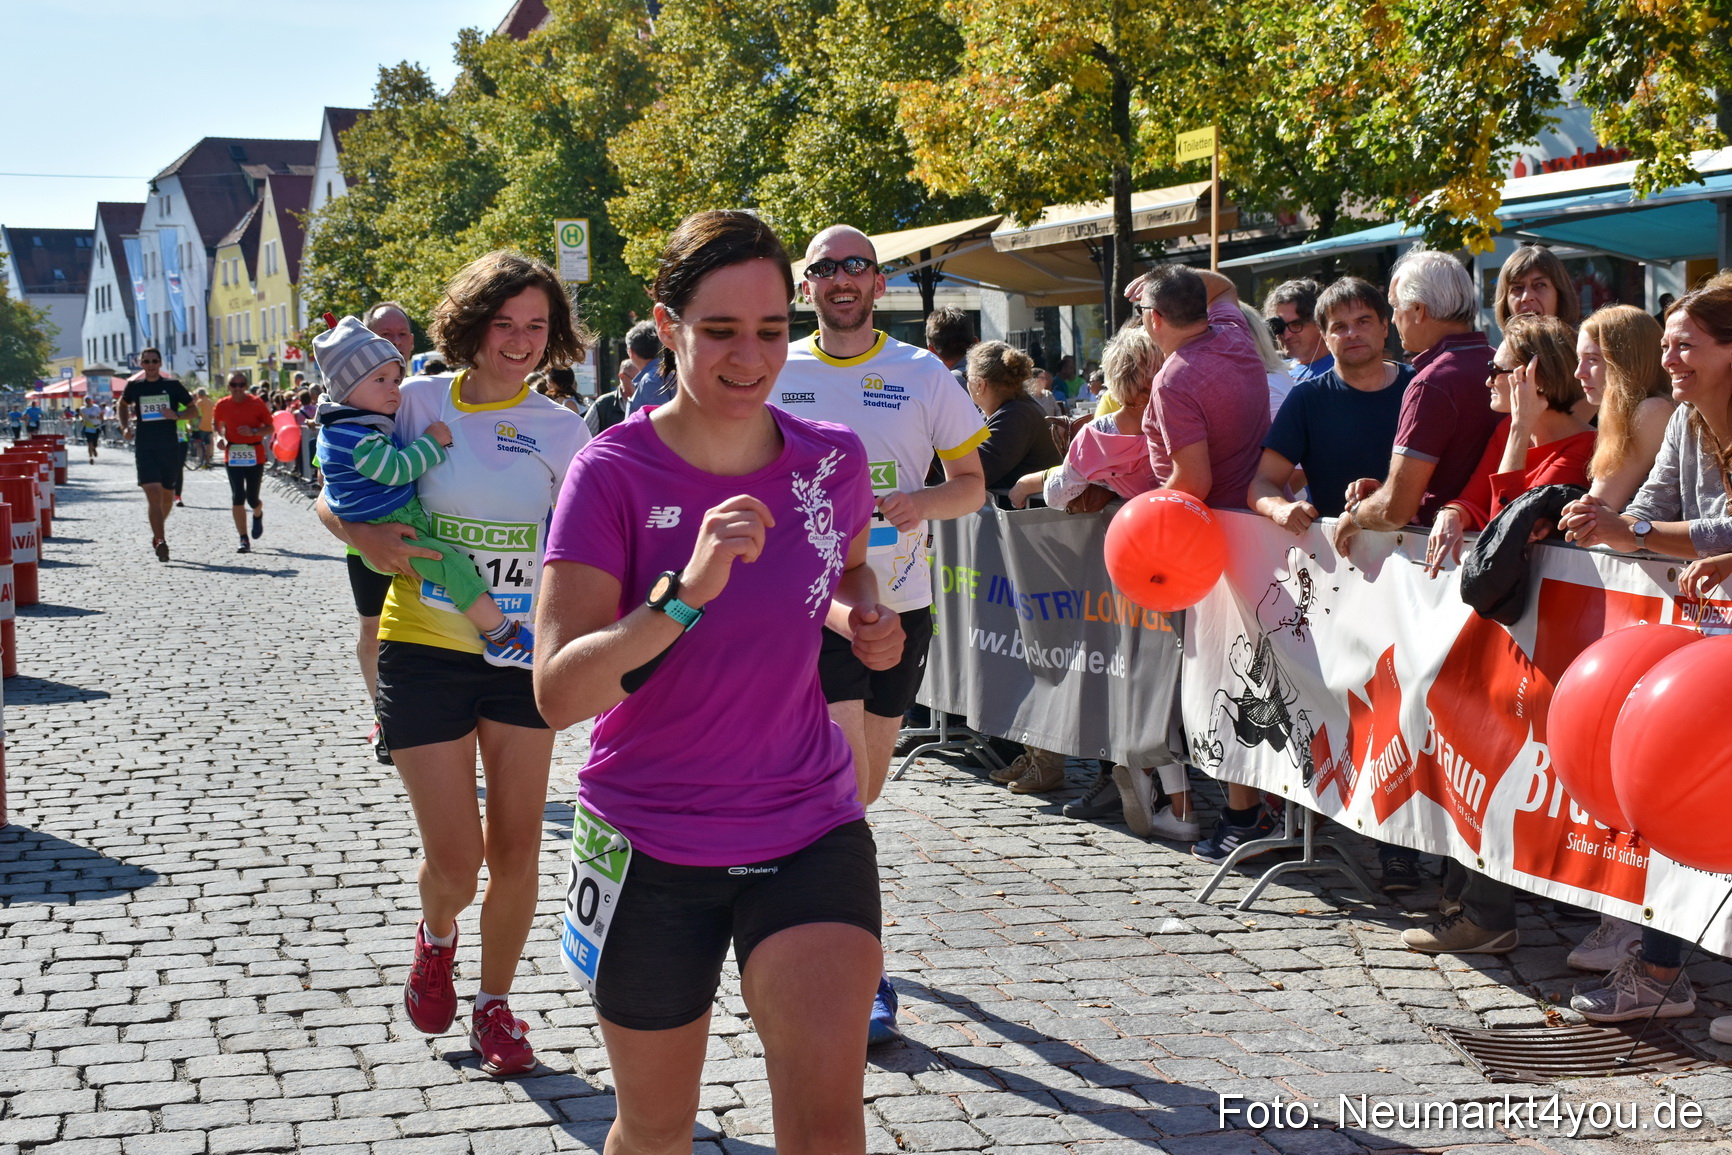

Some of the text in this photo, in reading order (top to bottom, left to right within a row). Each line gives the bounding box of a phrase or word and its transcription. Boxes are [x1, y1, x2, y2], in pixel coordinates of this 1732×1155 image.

[1183, 138, 1213, 153] Toiletten
[1541, 143, 1632, 174] vodafon
[566, 229, 578, 242] H
[863, 378, 883, 390] 20
[782, 393, 814, 401] BOCK
[863, 391, 911, 401] Neumarkter
[863, 400, 901, 410] Stadtlauf
[497, 424, 517, 438] 20
[231, 451, 253, 459] 2555
[437, 517, 530, 549] BOCK
[1518, 677, 1528, 700] 1929
[1370, 734, 1407, 793] Braun
[1420, 706, 1486, 813] Braun
[1566, 832, 1650, 869] Sicher ist sicher
[748, 866, 779, 876] Kalenji
